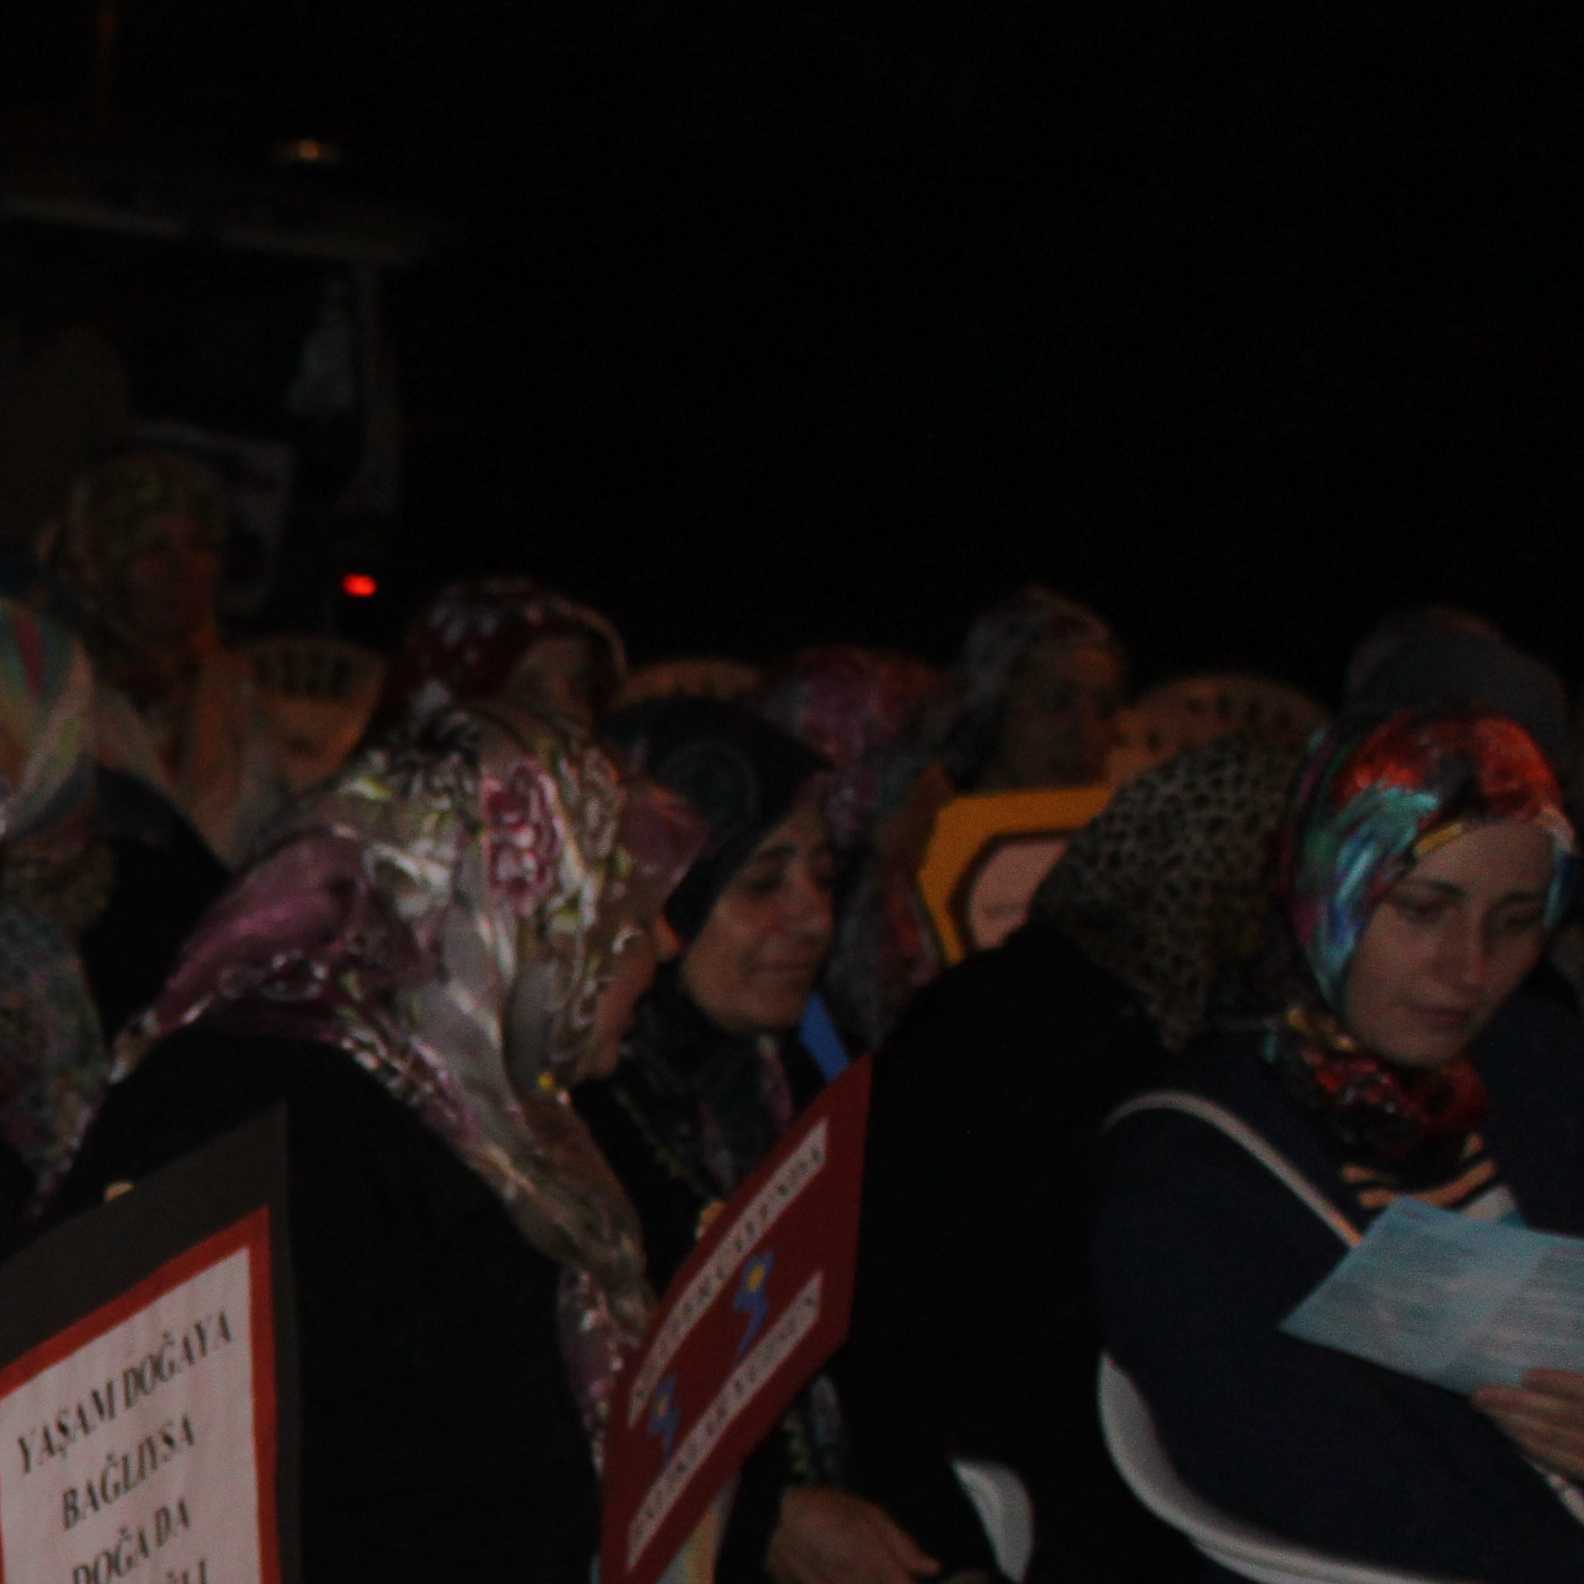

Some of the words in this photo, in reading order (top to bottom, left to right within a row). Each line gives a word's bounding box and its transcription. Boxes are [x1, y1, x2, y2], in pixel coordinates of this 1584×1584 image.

[17, 1378, 116, 1475] YAŞAM
[120, 1305, 232, 1409] DOĞAYA
[62, 1411, 196, 1531] BAĞLIYSA
[154, 1496, 192, 1548] DA
